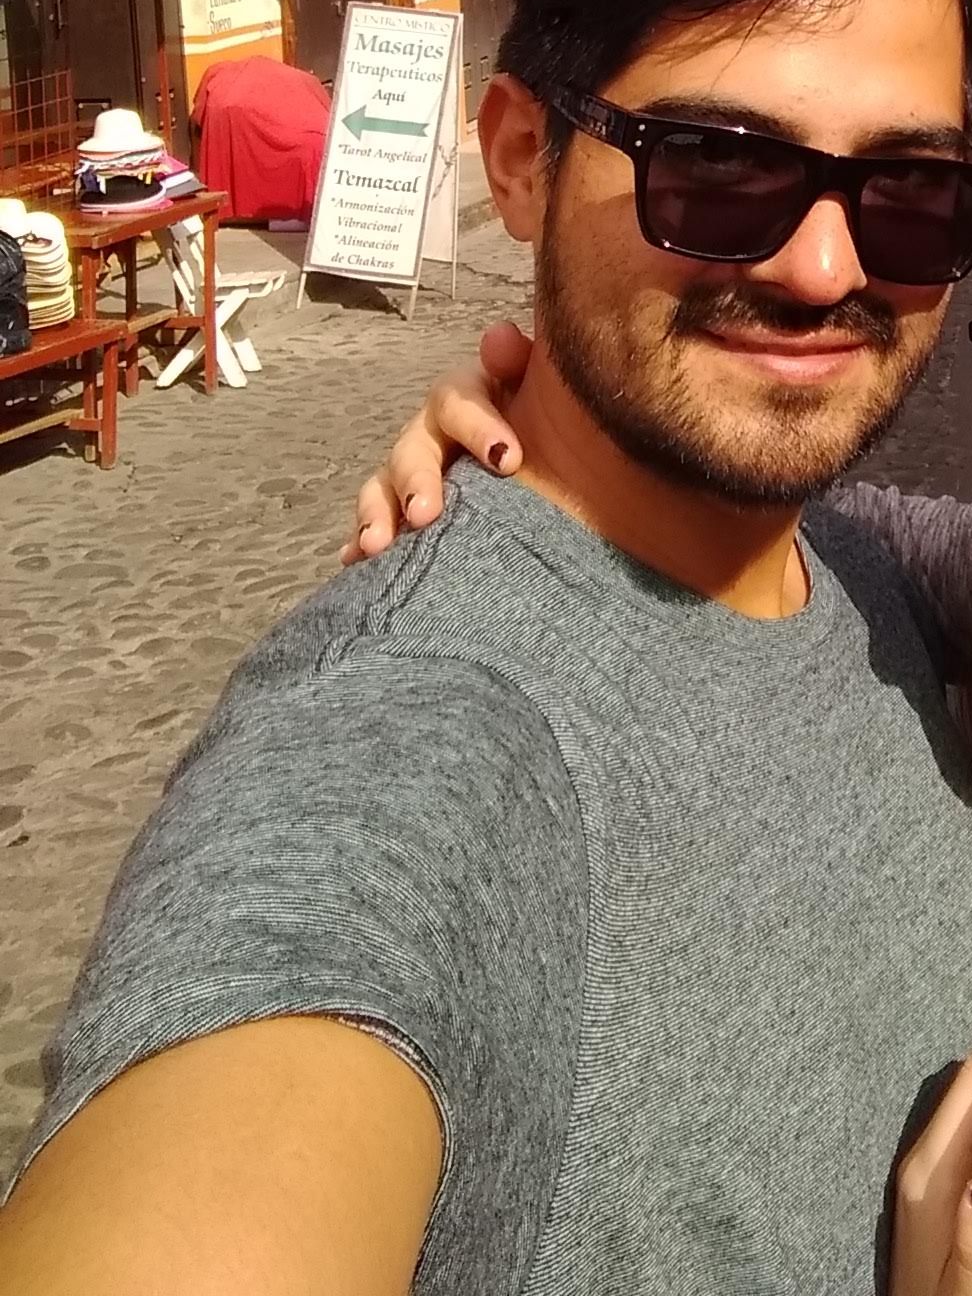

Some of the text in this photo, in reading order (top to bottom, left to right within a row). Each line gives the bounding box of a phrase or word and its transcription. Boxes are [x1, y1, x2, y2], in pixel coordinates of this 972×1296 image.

[354, 32, 445, 65] Masajes
[333, 169, 422, 194] Temazcal
[338, 216, 403, 234] Vibracional
[331, 251, 395, 269] de Chakras
